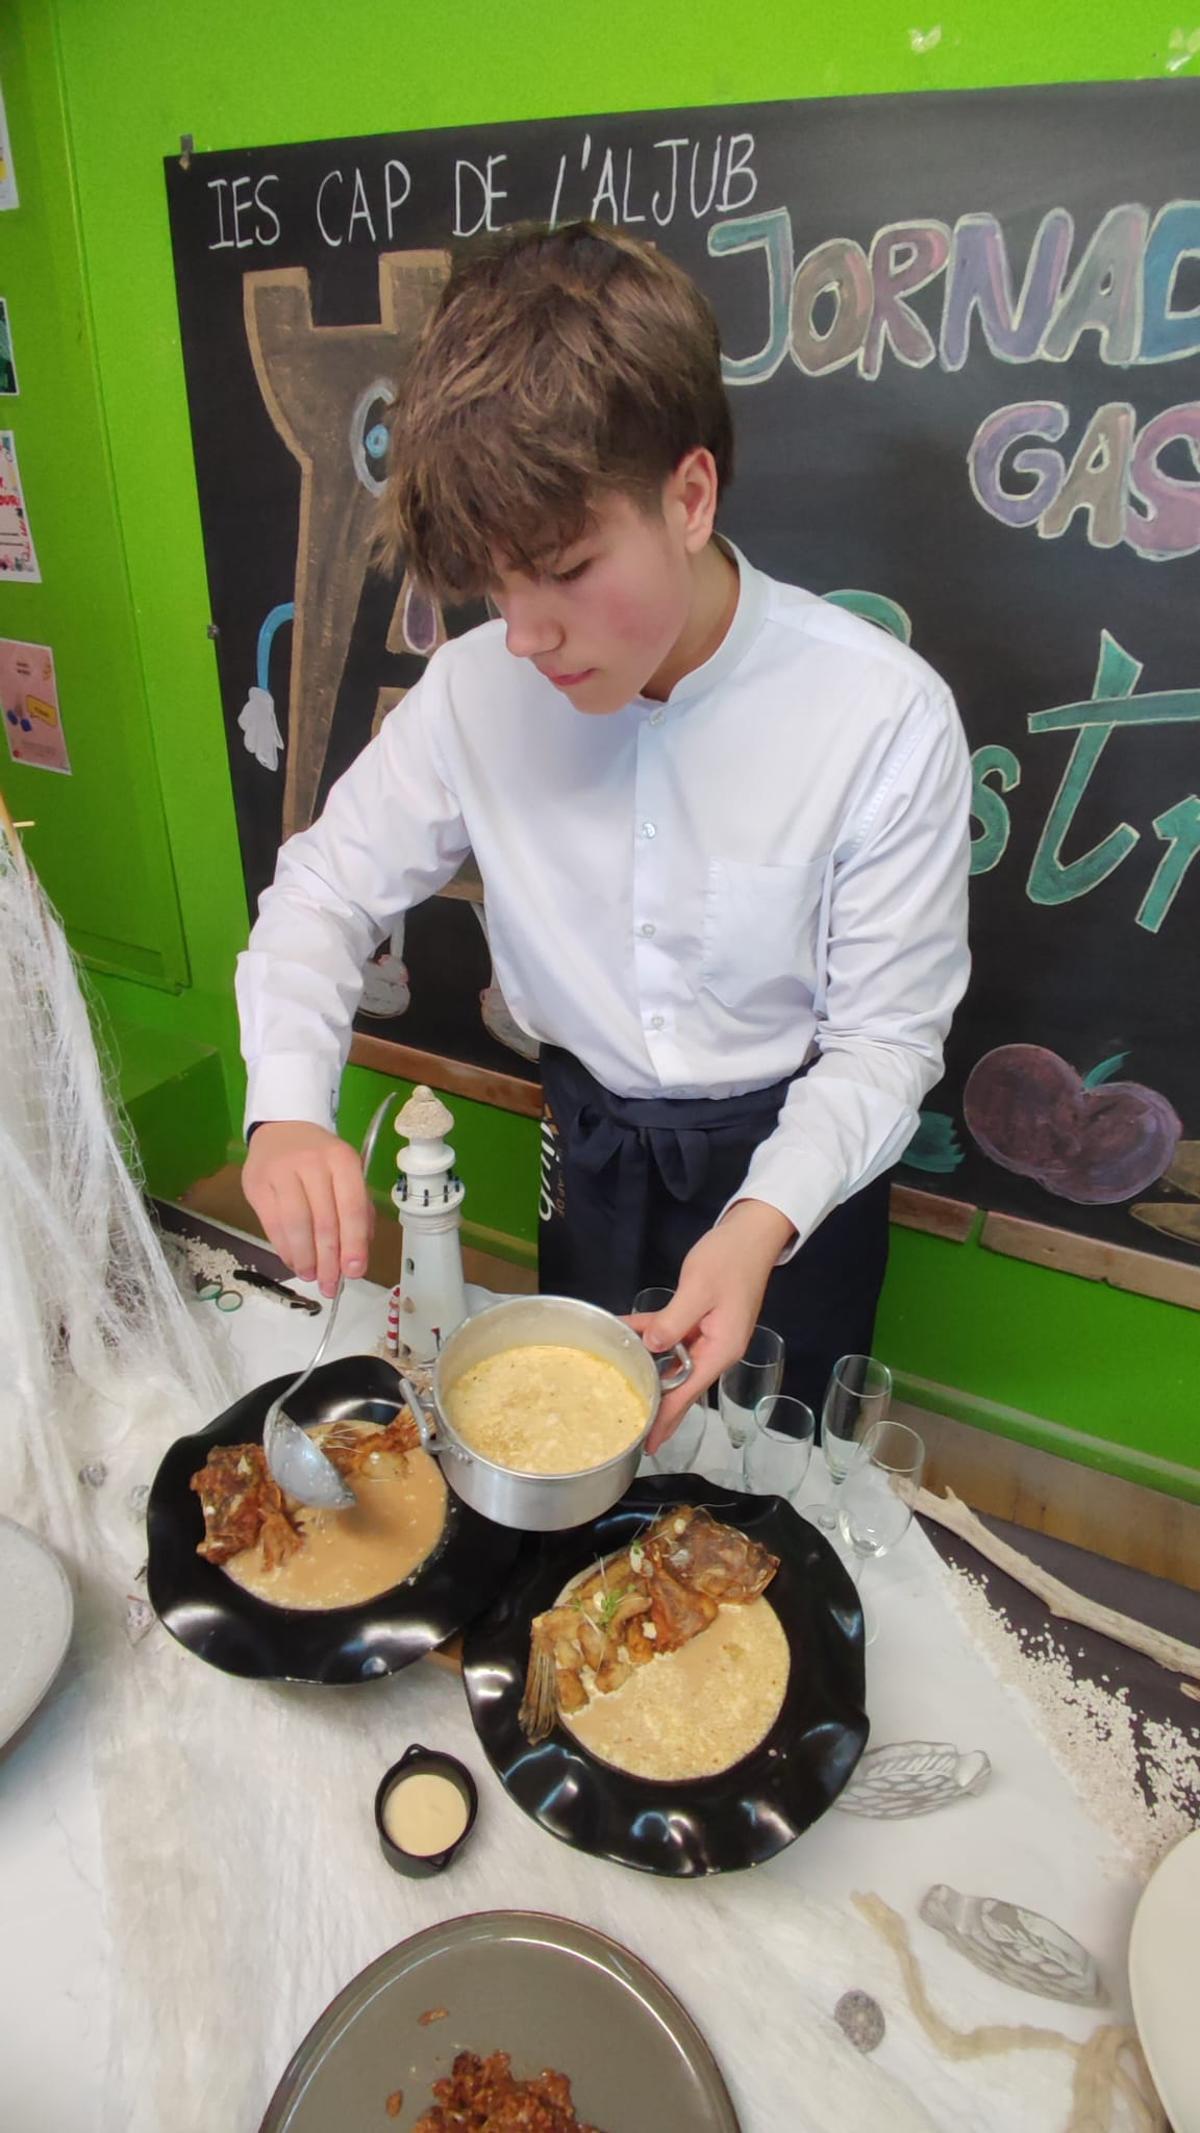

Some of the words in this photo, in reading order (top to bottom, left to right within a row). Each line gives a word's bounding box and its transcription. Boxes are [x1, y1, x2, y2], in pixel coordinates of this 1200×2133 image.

[207, 174, 281, 250] IES
[316, 159, 412, 247] CAP
[452, 154, 508, 237] DE
[967, 401, 1200, 562] GAS
